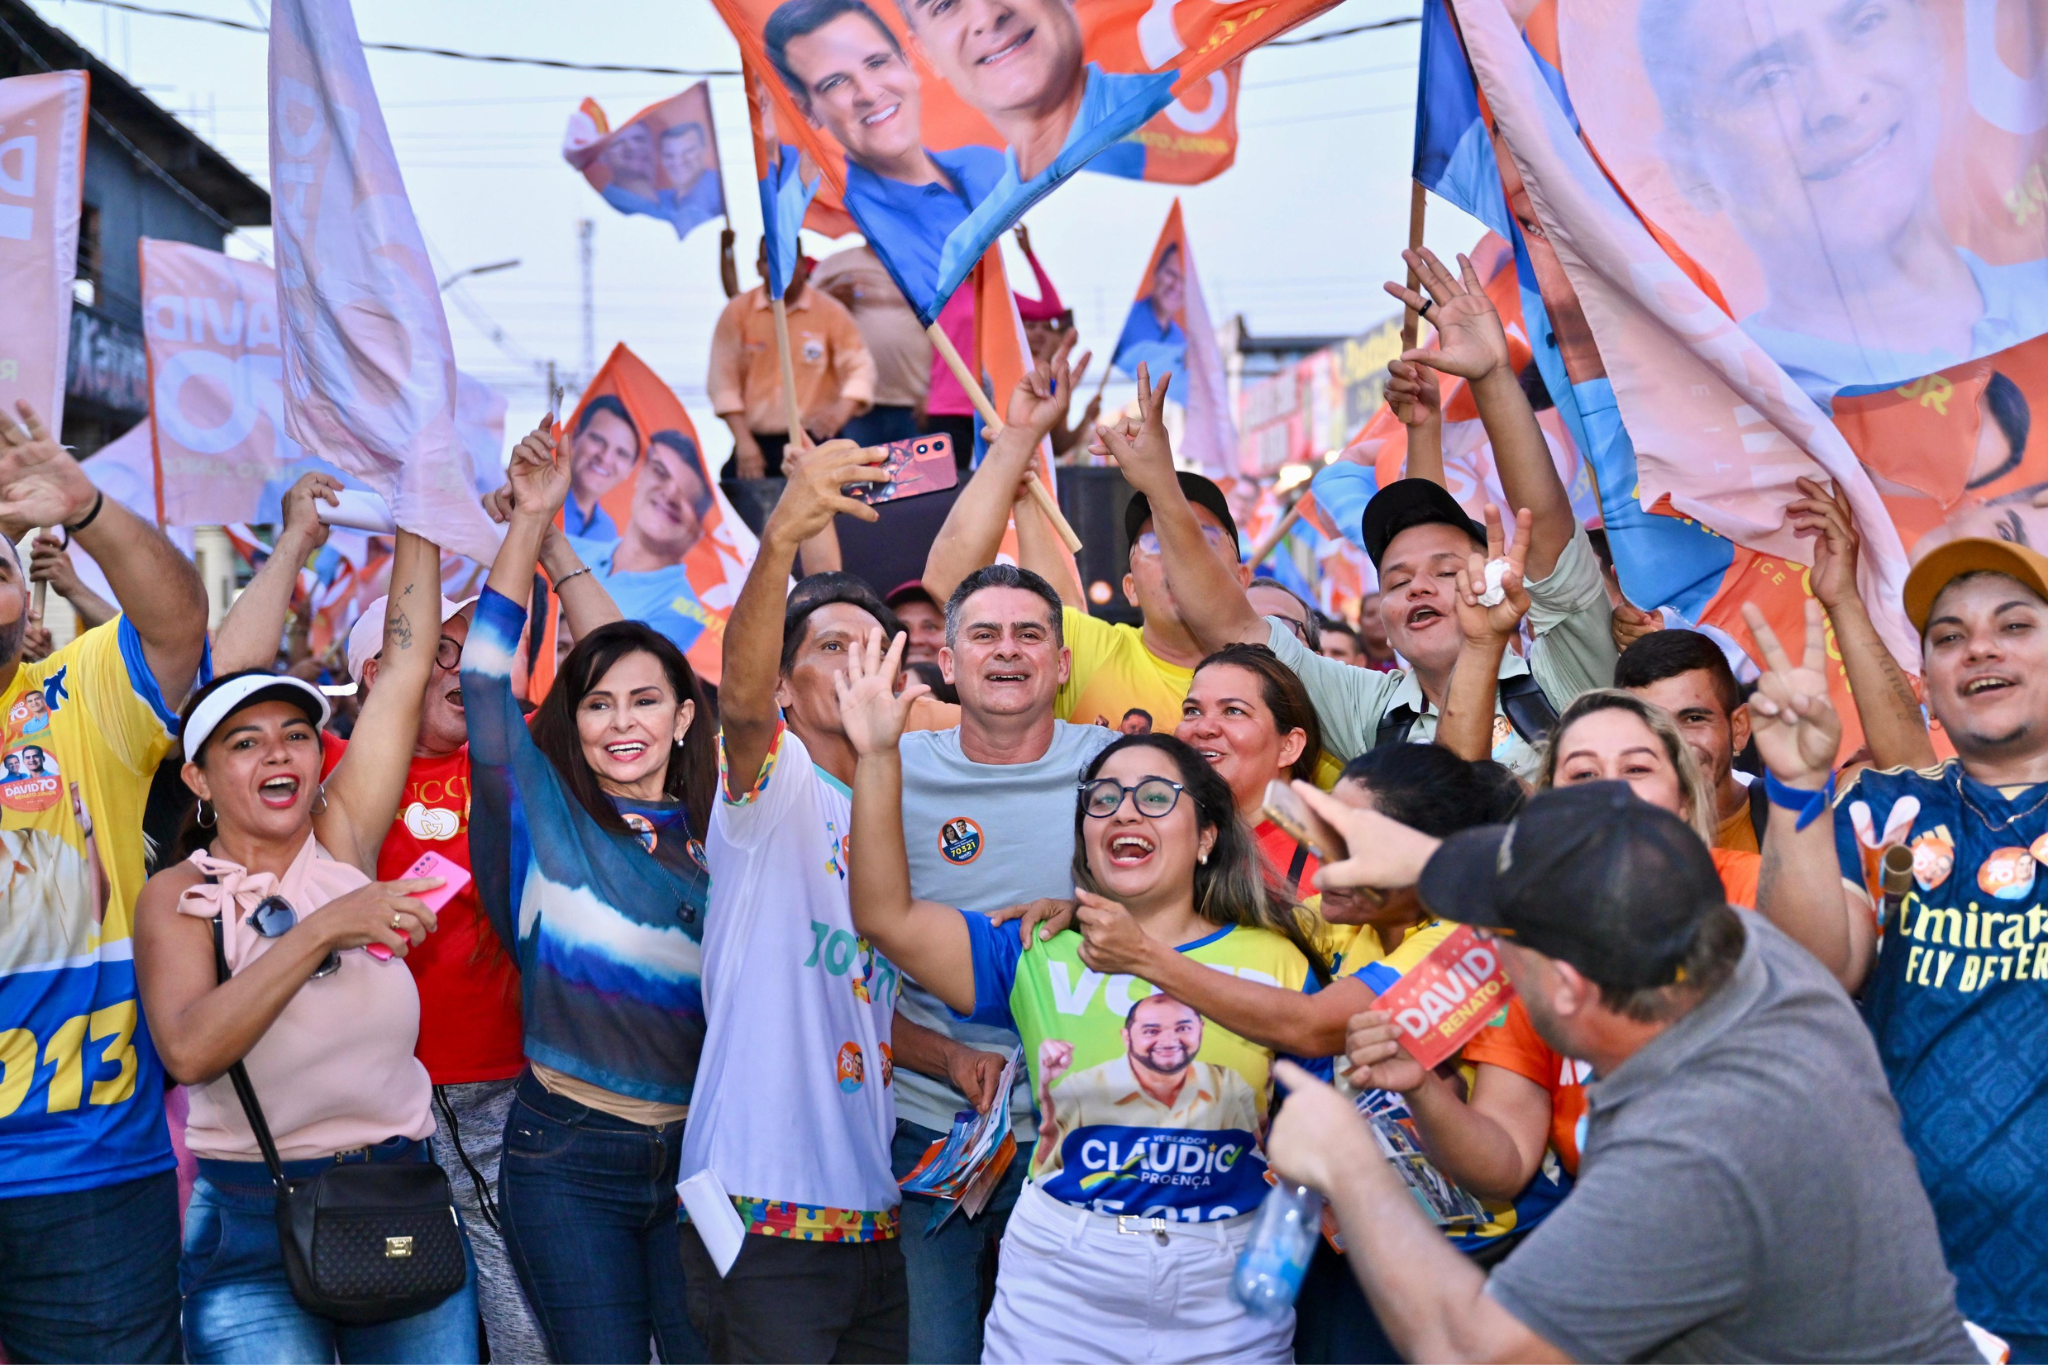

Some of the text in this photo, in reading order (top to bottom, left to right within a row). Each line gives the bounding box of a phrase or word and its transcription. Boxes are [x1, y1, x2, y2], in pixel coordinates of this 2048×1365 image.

[4, 783, 40, 798] DAVID
[37, 778, 58, 792] 70
[950, 841, 977, 858] 70321
[1905, 945, 1955, 988] FLY
[1395, 947, 1496, 1039] DAVID
[1438, 979, 1501, 1039] RENATO
[1153, 1134, 1208, 1146] VEREADOR
[1141, 1171, 1211, 1190] PROENÇA
